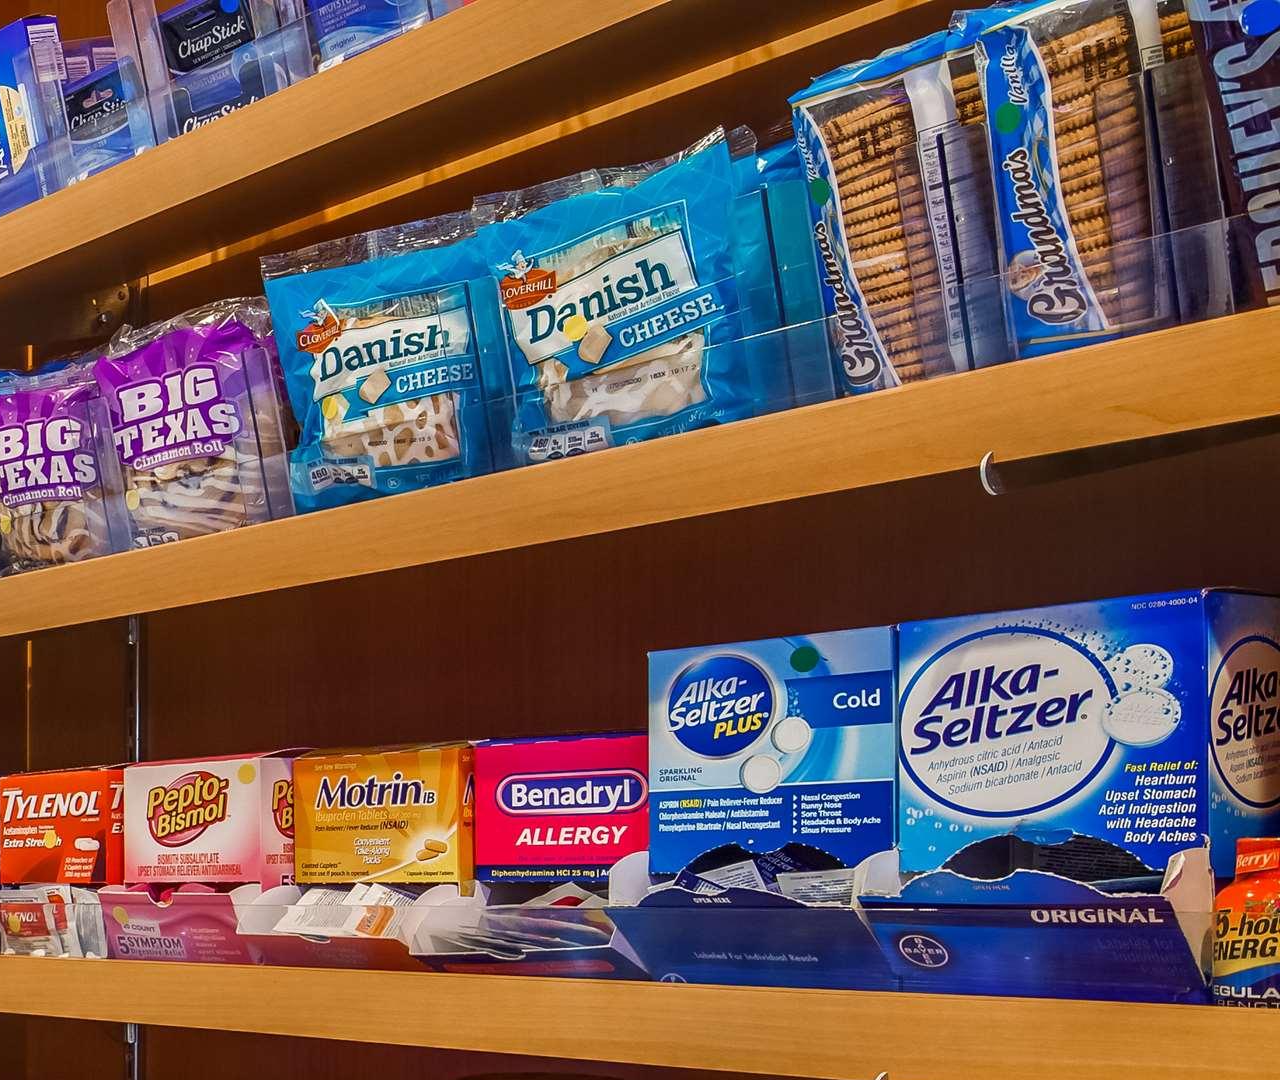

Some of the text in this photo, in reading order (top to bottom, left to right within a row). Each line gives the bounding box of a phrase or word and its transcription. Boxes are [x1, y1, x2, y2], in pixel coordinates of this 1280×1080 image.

[178, 15, 246, 59] ChapStick
[329, 33, 357, 52] original
[1005, 42, 1028, 106] Vanilla
[999, 146, 1089, 327] Grandma's
[526, 258, 676, 344] Danish
[812, 221, 882, 388] Grandma's
[618, 292, 717, 348] CHEESE
[319, 324, 451, 382] Danish
[395, 362, 474, 394] CHEESE
[117, 367, 220, 423] BIG
[115, 402, 240, 461] TEXAS
[132, 438, 225, 472] Cinnamon Roll
[2, 485, 83, 508] Cinnamon Roll
[1131, 601, 1147, 610] NDC
[672, 676, 748, 708] Alka-
[832, 688, 881, 709] Cold
[919, 664, 1060, 717] Alka-
[669, 691, 766, 733] Seltzer
[910, 689, 1094, 756] Seltzer
[713, 713, 763, 740] PLUS
[928, 745, 1021, 772] Anhydrous citric acid
[1124, 759, 1199, 773] Fast Relief of:
[659, 767, 703, 776] SPARKLING
[659, 774, 697, 782] ORIGINAL
[936, 760, 1009, 784] Aspirin (NSAID)
[948, 769, 1039, 796] Sodium bicarbonate
[1134, 773, 1196, 786] Heartburn
[147, 776, 229, 818] Pepto-
[315, 772, 436, 809] Motrin IB
[511, 778, 631, 808] Benadryl
[821, 793, 860, 802] Congestion
[1105, 788, 1196, 803] Upset Stomach
[2, 790, 100, 824] TYLENOL
[156, 790, 226, 839] Bismol
[315, 809, 388, 822] Ibuprofen Tablets
[800, 802, 822, 810] Runny
[818, 810, 842, 818] Throat
[1098, 802, 1196, 817] Acid Indigestion
[380, 820, 409, 830] (NSAID)
[800, 816, 881, 826] Headache Body Ache
[800, 826, 852, 834] Sinus Pressure
[1106, 816, 1196, 830] with Headache
[3, 838, 24, 848] Extra
[514, 825, 629, 847] ALLERGY
[1124, 830, 1196, 845] Body Aches
[157, 853, 179, 865] BISMUTH
[491, 869, 555, 878] Diphenhydramine
[582, 871, 596, 879] mg
[1030, 906, 1164, 925] ORIGINAL
[127, 936, 183, 950] SYMPTOM
